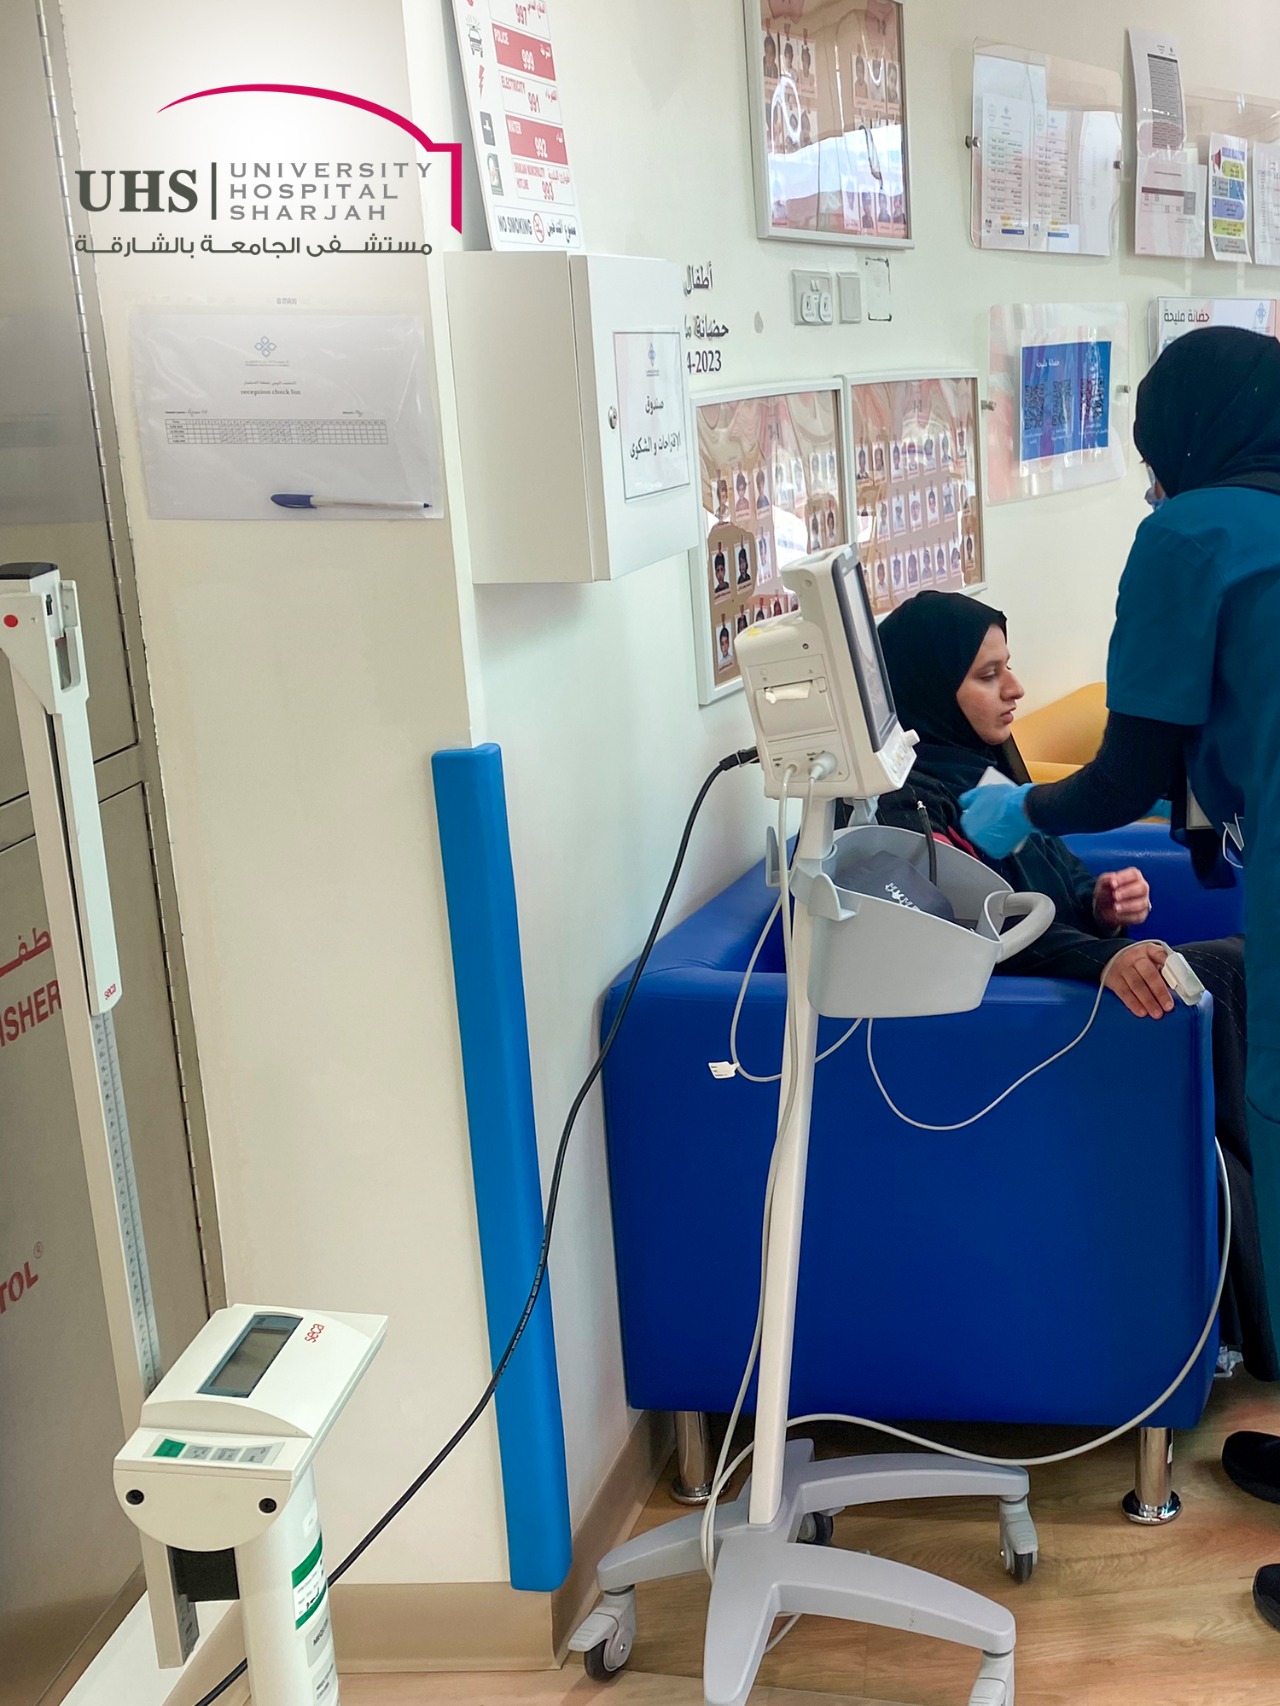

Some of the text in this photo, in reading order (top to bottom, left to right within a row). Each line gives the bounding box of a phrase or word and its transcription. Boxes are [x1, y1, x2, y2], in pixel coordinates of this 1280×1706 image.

[521, 48, 535, 72] 999
[527, 92, 541, 113] 991
[534, 136, 548, 158] 992
[542, 181, 554, 201] 993
[497, 215, 533, 236] NO SMOKING
[1163, 308, 1210, 326] حضانة مليحة
[241, 388, 271, 397] reception
[272, 388, 290, 396] check
[104, 983, 117, 1000] seca
[304, 1323, 325, 1344] seca
